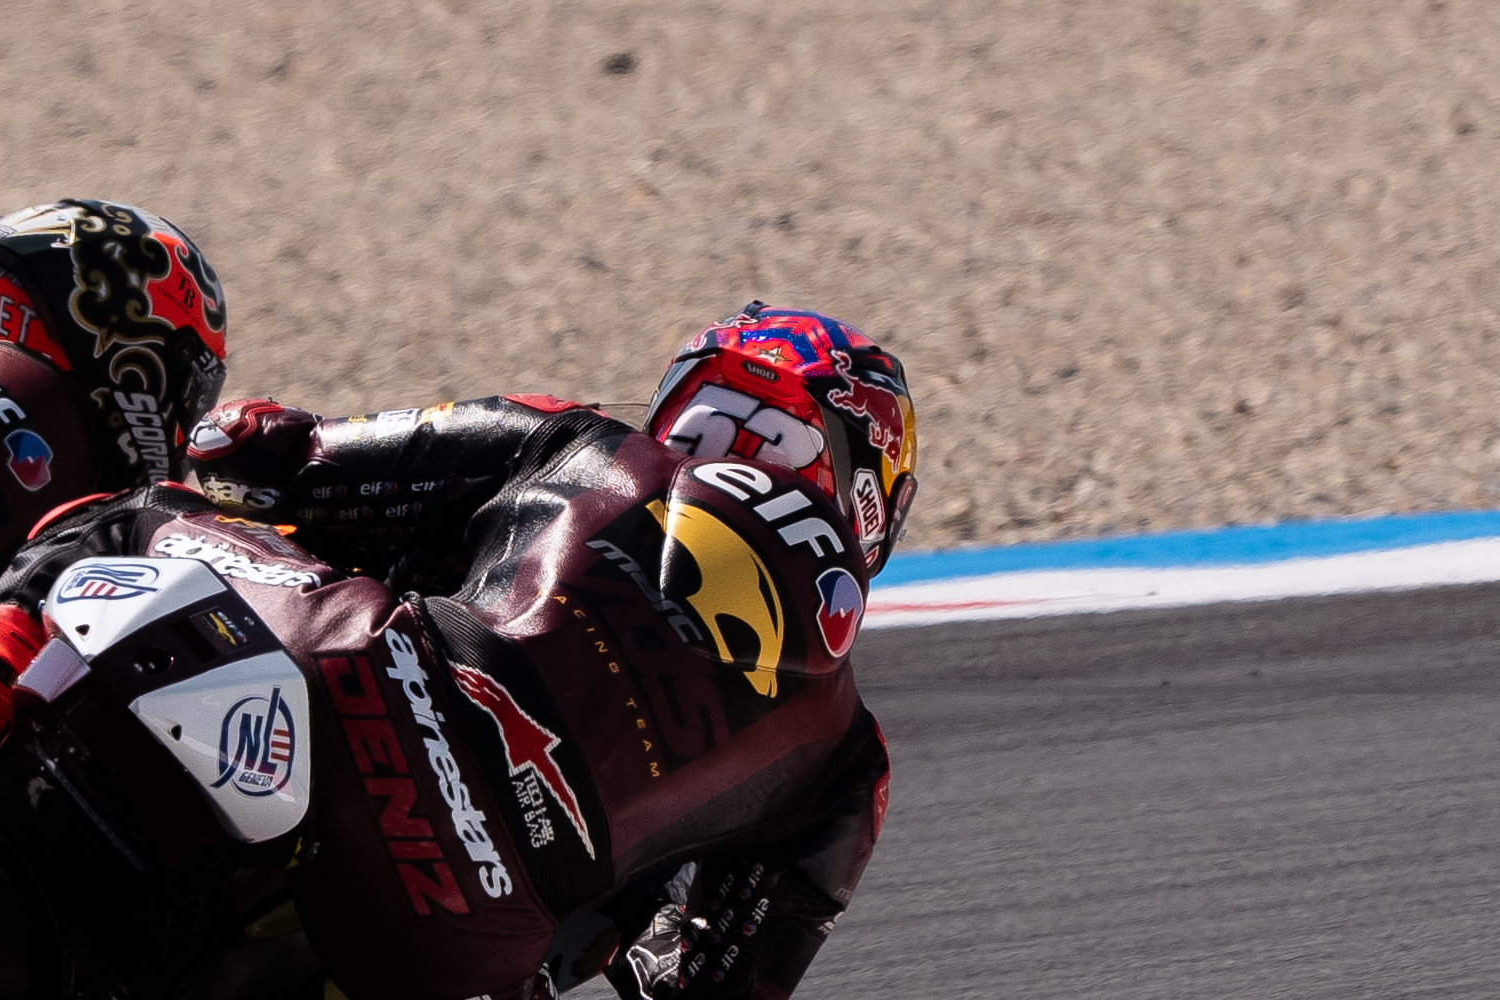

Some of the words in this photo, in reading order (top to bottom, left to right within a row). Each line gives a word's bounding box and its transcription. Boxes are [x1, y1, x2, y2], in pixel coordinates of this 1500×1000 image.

[746, 363, 777, 382] SHOEI
[312, 485, 334, 499] elf
[360, 481, 383, 496] elf
[339, 507, 359, 521] elf
[386, 504, 410, 519] elf
[693, 463, 845, 557] elf
[856, 478, 879, 537] SHOEI
[586, 539, 704, 643] marc
[626, 698, 660, 778] TEAM
[385, 627, 513, 898] alpinestars
[238, 771, 274, 788] GENEVA
[317, 656, 471, 917] DENIZ
[751, 897, 770, 925] elf
[688, 952, 706, 978] elf
[721, 944, 739, 971] elf
